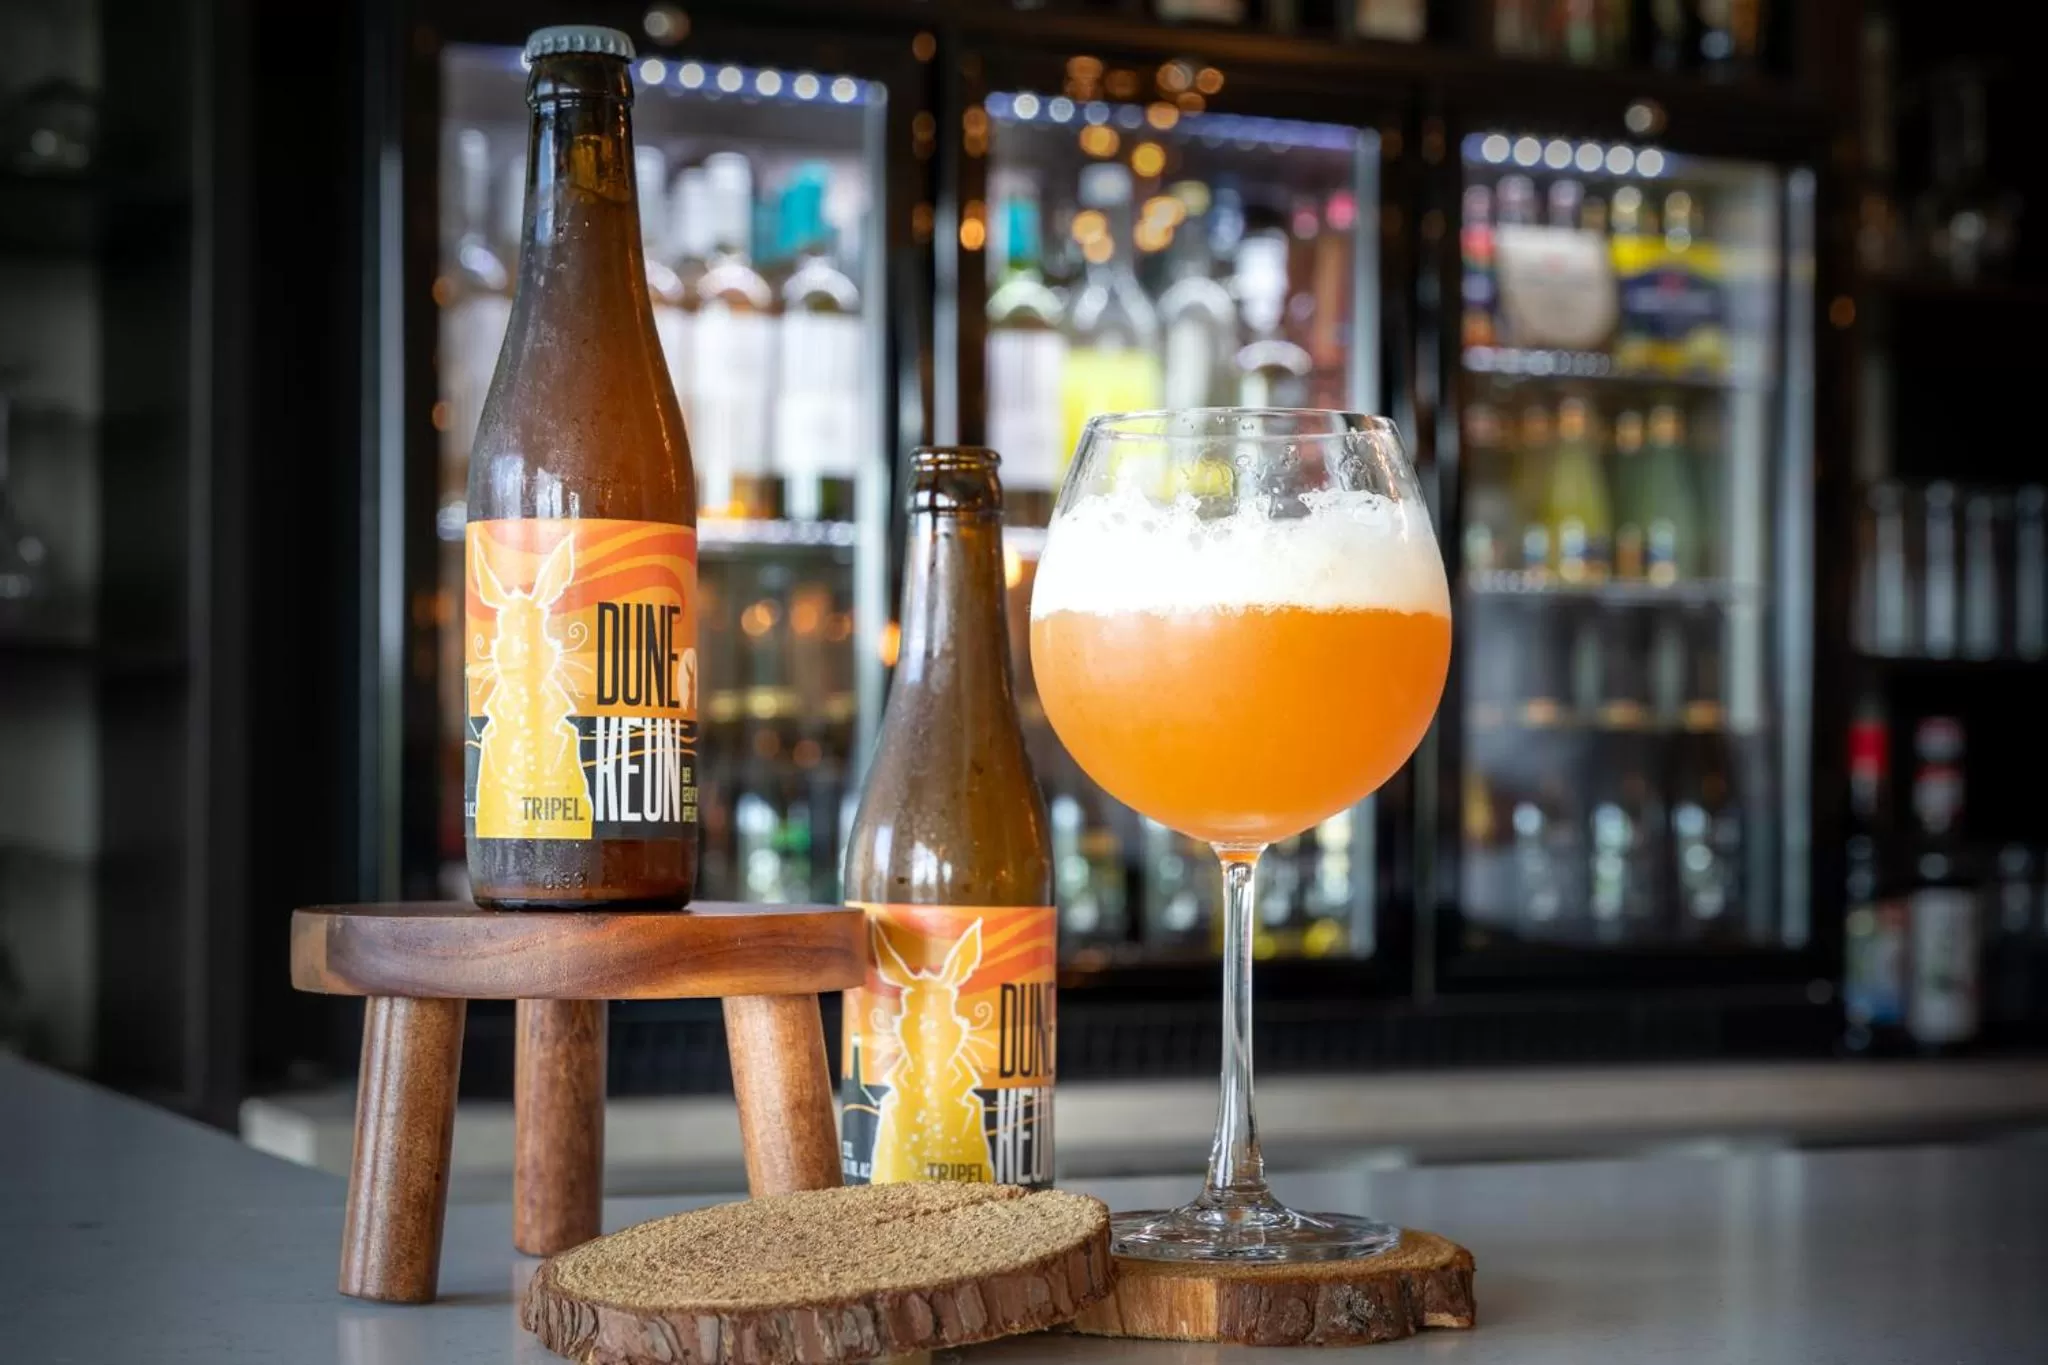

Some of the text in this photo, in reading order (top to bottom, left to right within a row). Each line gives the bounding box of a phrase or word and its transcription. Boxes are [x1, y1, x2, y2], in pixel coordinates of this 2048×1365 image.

[596, 602, 680, 708] DUNE
[522, 796, 585, 821] TRIPEL
[596, 716, 680, 822] KEUN
